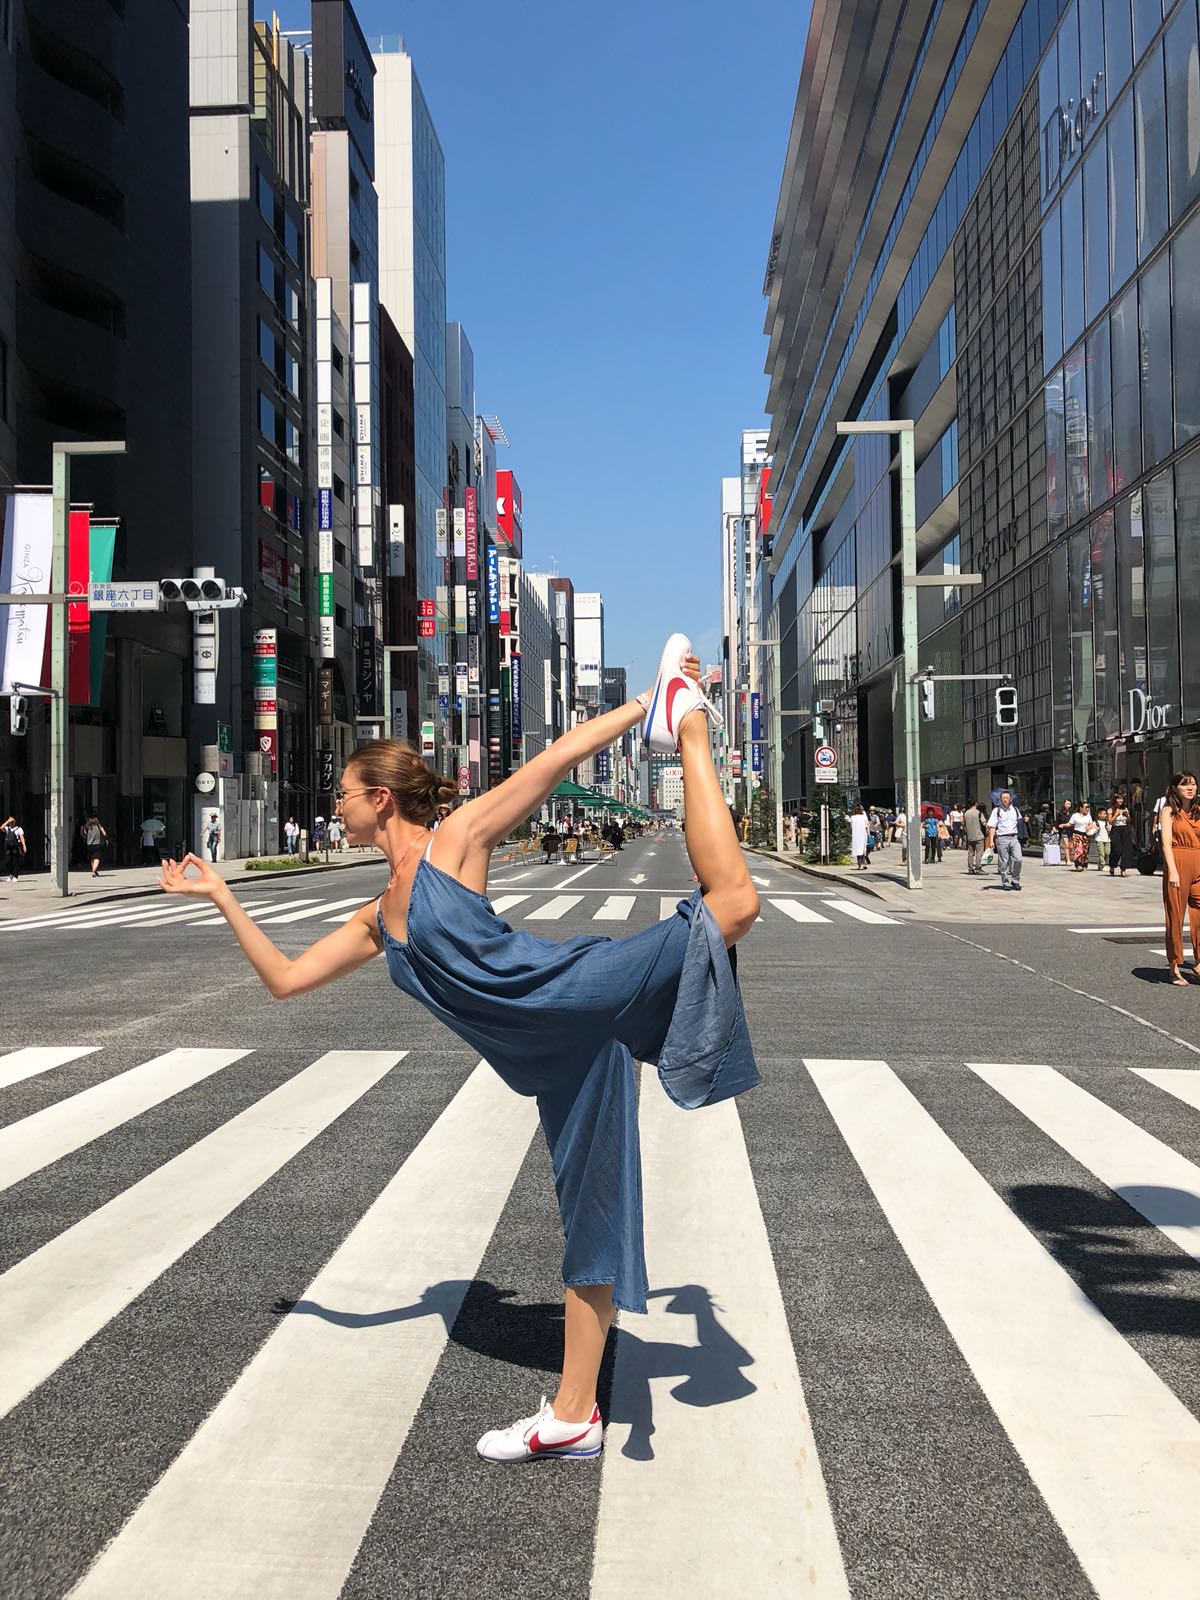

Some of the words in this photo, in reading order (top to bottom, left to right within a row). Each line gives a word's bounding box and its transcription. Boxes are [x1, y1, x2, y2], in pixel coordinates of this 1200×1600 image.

[1041, 71, 1104, 203] Dior
[23, 543, 31, 569] GINZA
[467, 526, 476, 573] NATARAJ
[93, 589, 154, 601] 銀座六丁目
[488, 549, 497, 612] アートネイチャー
[110, 600, 129, 609] Ginza
[321, 680, 331, 710] マギー
[1128, 688, 1171, 734] Dior
[322, 753, 333, 791] タカゲン
[665, 769, 683, 777] LIXIL
